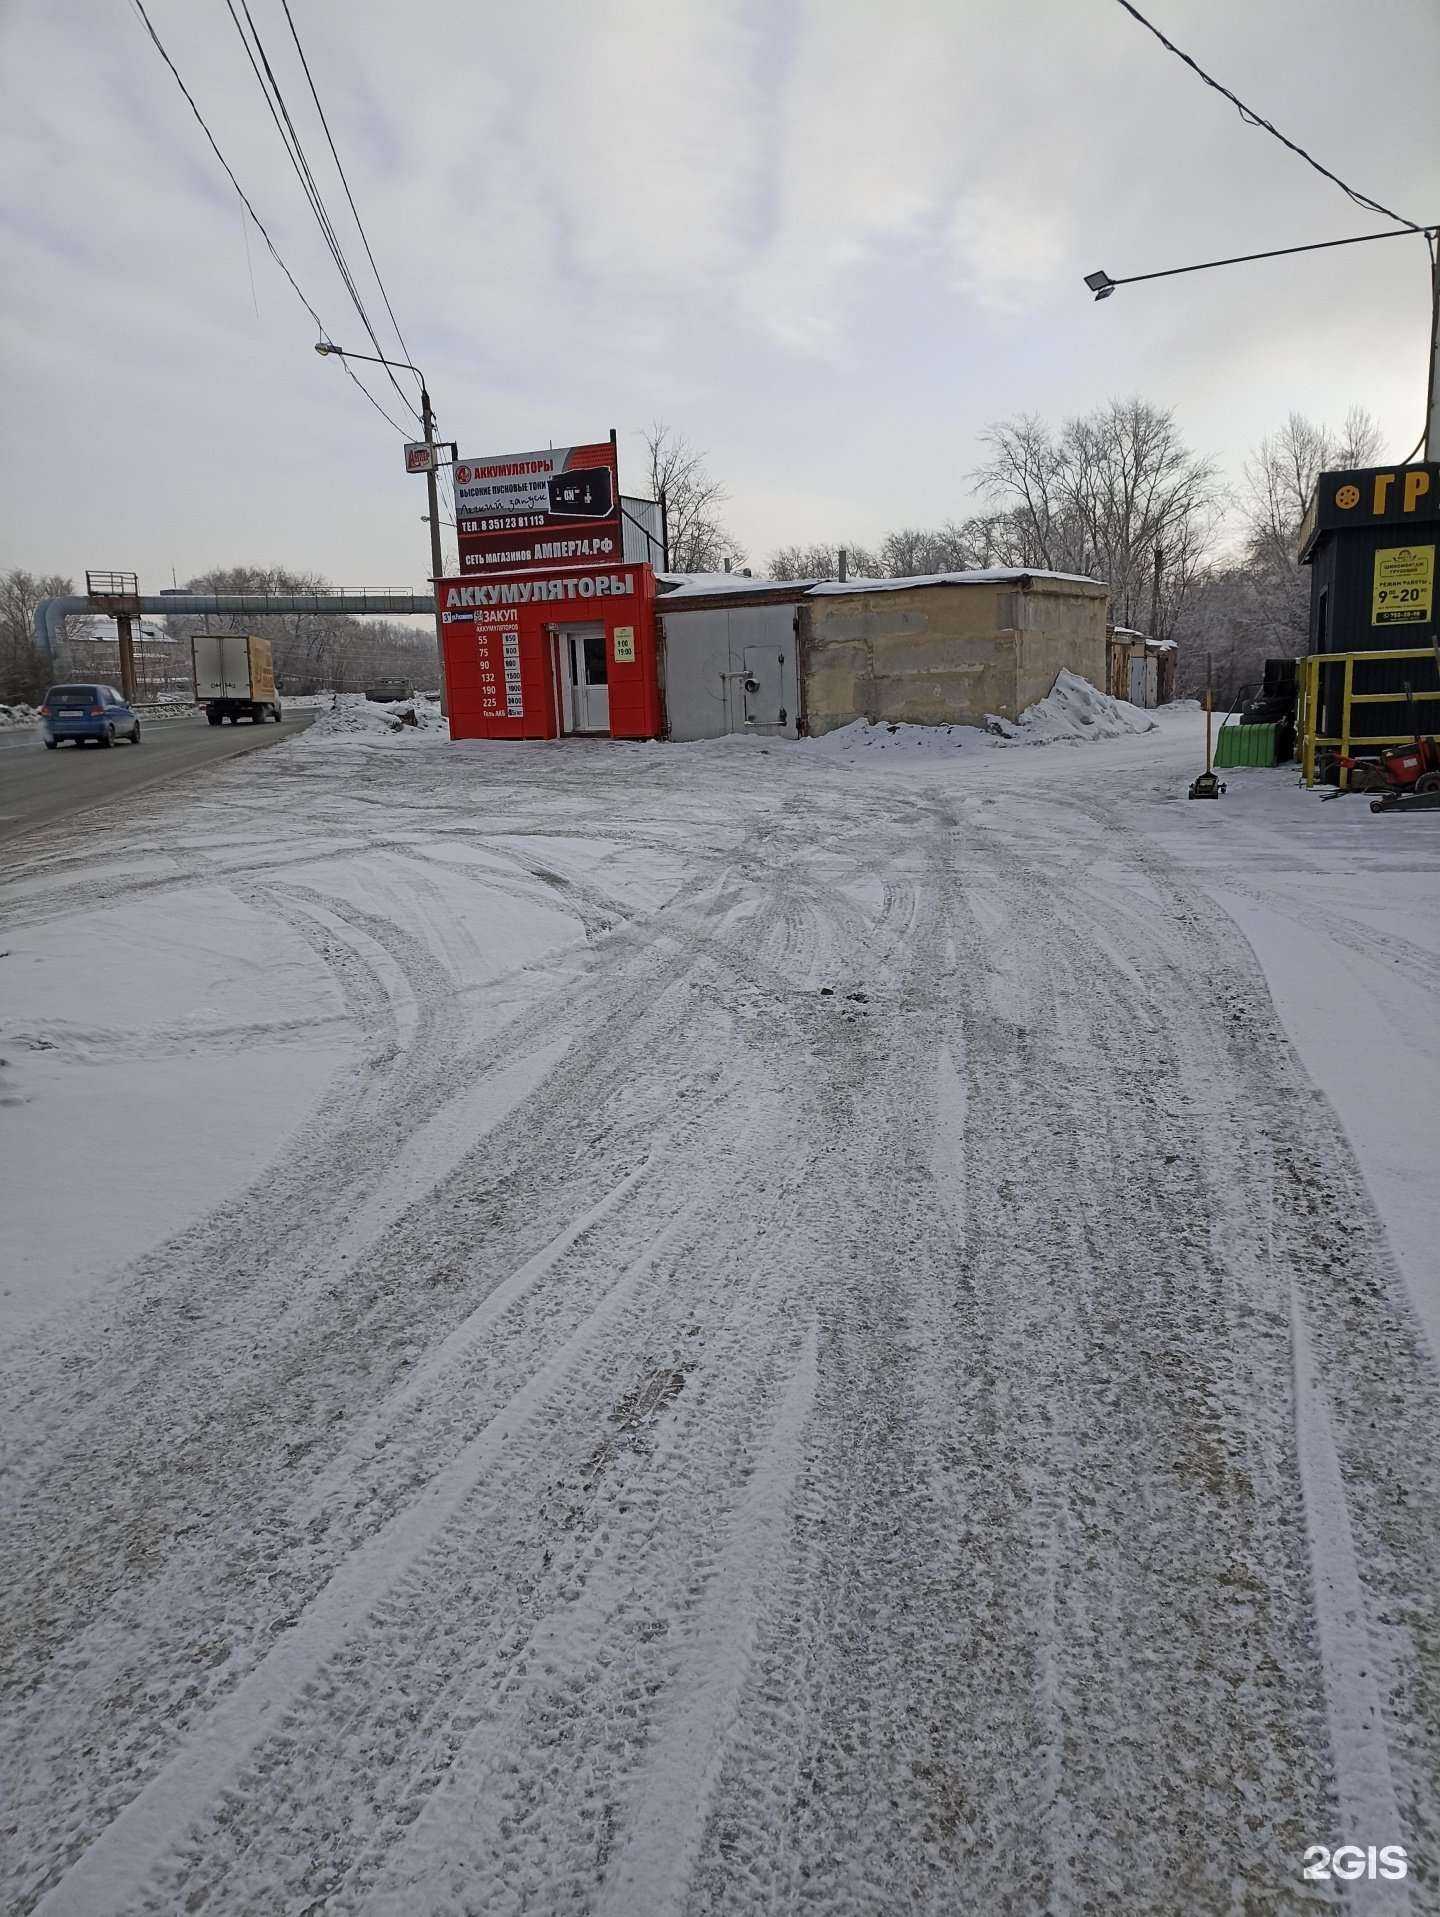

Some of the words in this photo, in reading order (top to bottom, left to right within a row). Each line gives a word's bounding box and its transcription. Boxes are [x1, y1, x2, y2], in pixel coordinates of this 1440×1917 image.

[474, 459, 553, 479] АККУМУЛЯТОРЫ
[459, 486, 491, 498] ВЫСОКИЕ
[492, 482, 528, 495] ПУСКОВЫЕ
[465, 553, 485, 566] СЕТЬ
[485, 549, 532, 564] МАГАЗИНОВ
[533, 537, 613, 560] АМПЕР74.РФ
[446, 574, 634, 607] АККУМУЛЯТОРЫ
[483, 609, 518, 622] ЗАКУП
[478, 635, 488, 645] 55
[479, 648, 488, 657] 75
[479, 661, 490, 670] 90
[481, 673, 495, 682] 132
[482, 686, 496, 695] 190
[483, 699, 497, 707] 225
